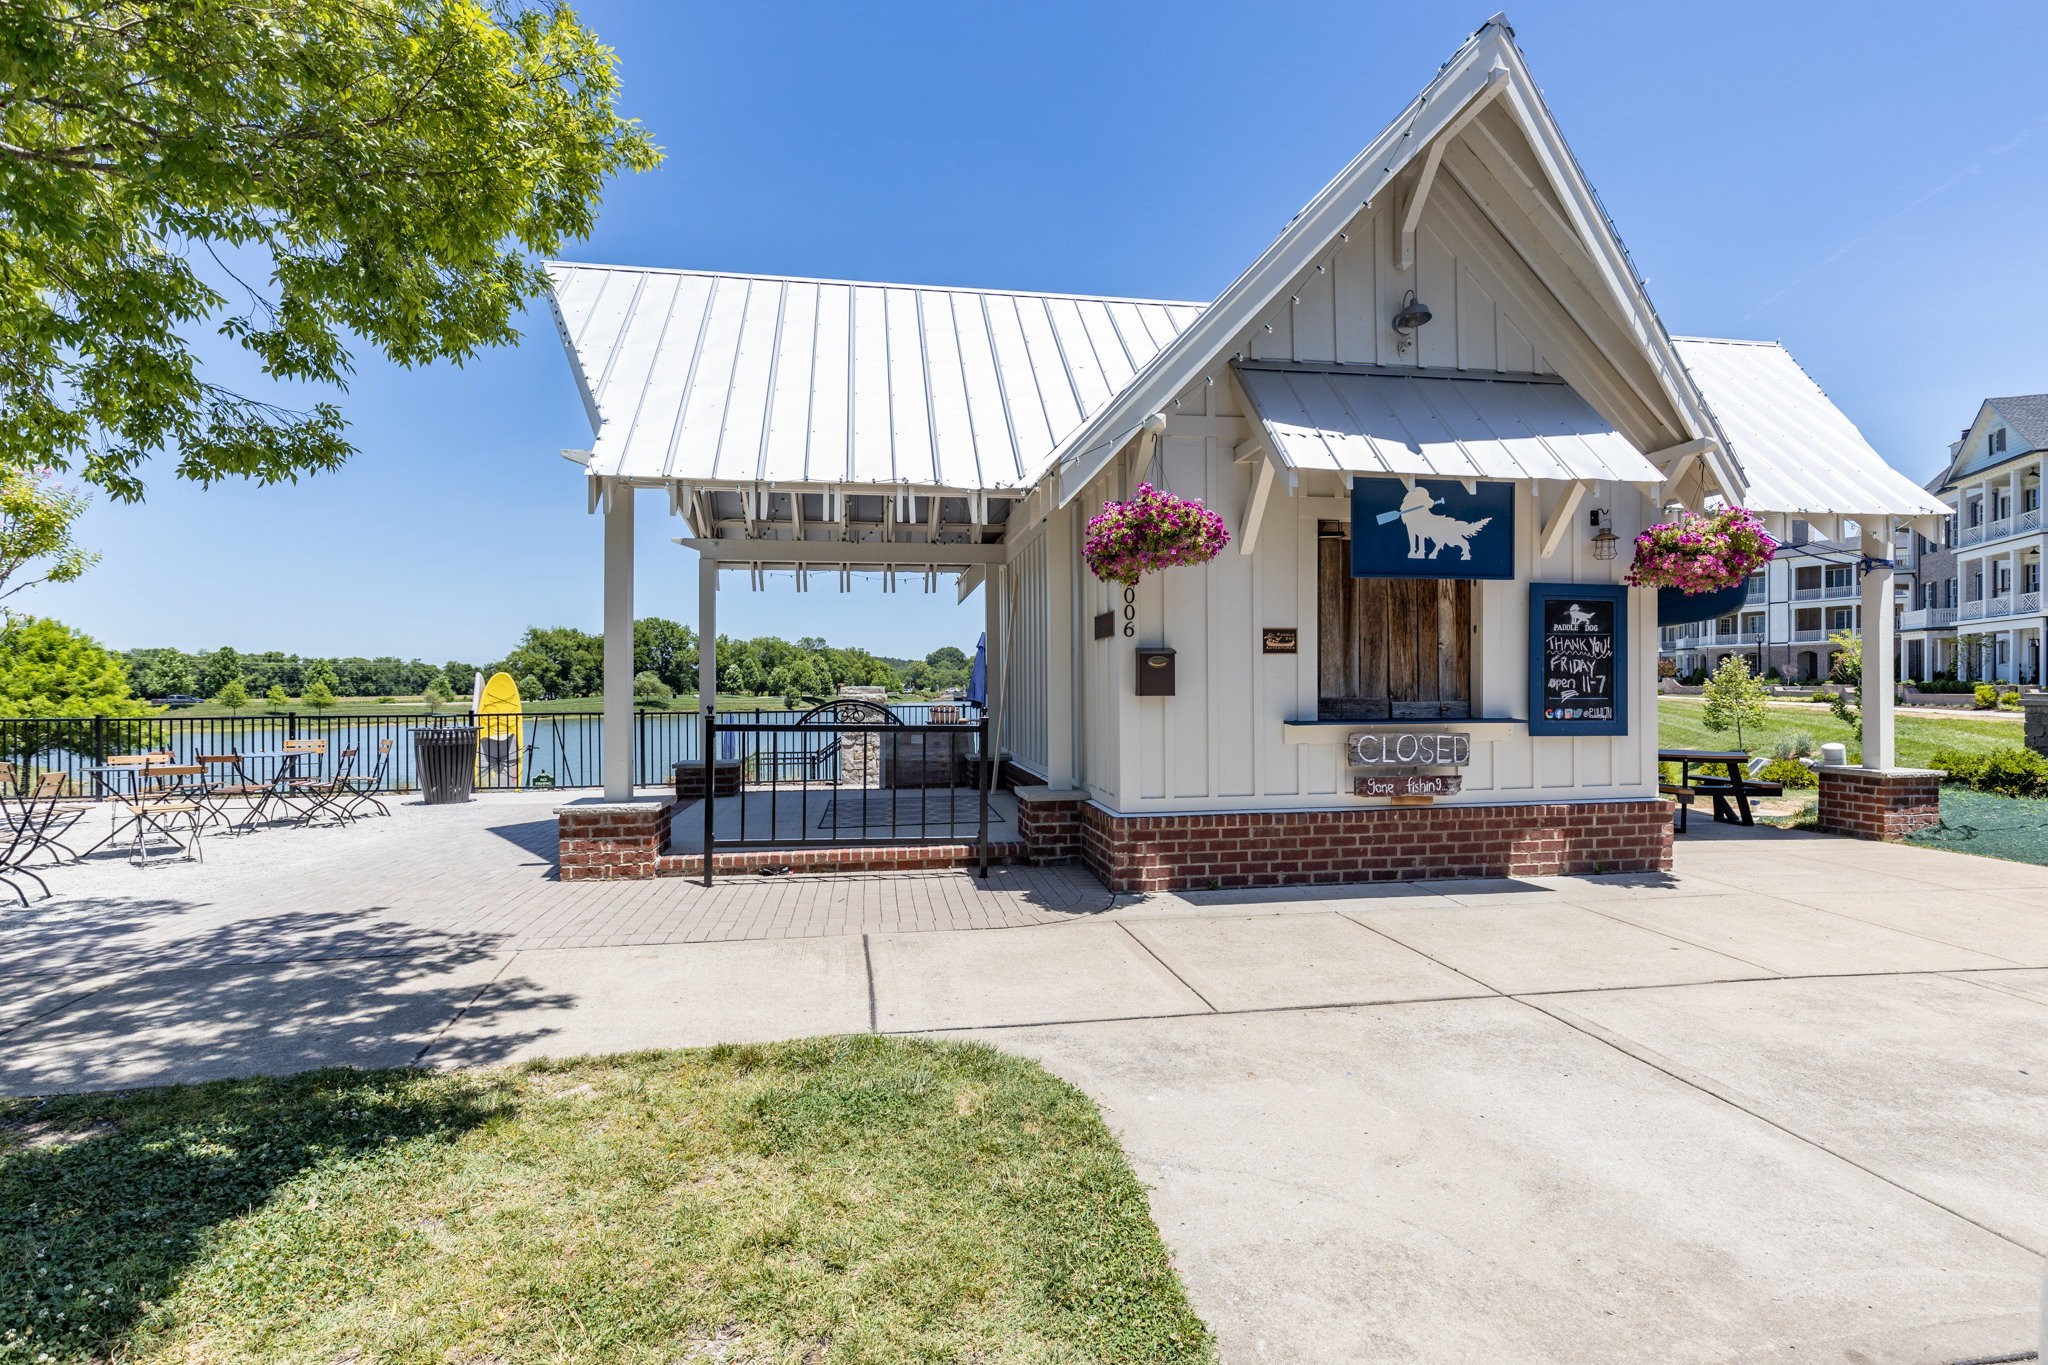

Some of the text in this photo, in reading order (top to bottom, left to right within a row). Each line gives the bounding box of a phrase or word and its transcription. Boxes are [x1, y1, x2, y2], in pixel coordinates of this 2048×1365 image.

[1124, 585, 1135, 637] 006
[1546, 635, 1588, 651] THANK
[1550, 655, 1596, 678] FRIDAY
[1582, 674, 1606, 693] 11-7
[1358, 734, 1470, 764] CLOSED
[1367, 778, 1394, 795] gone
